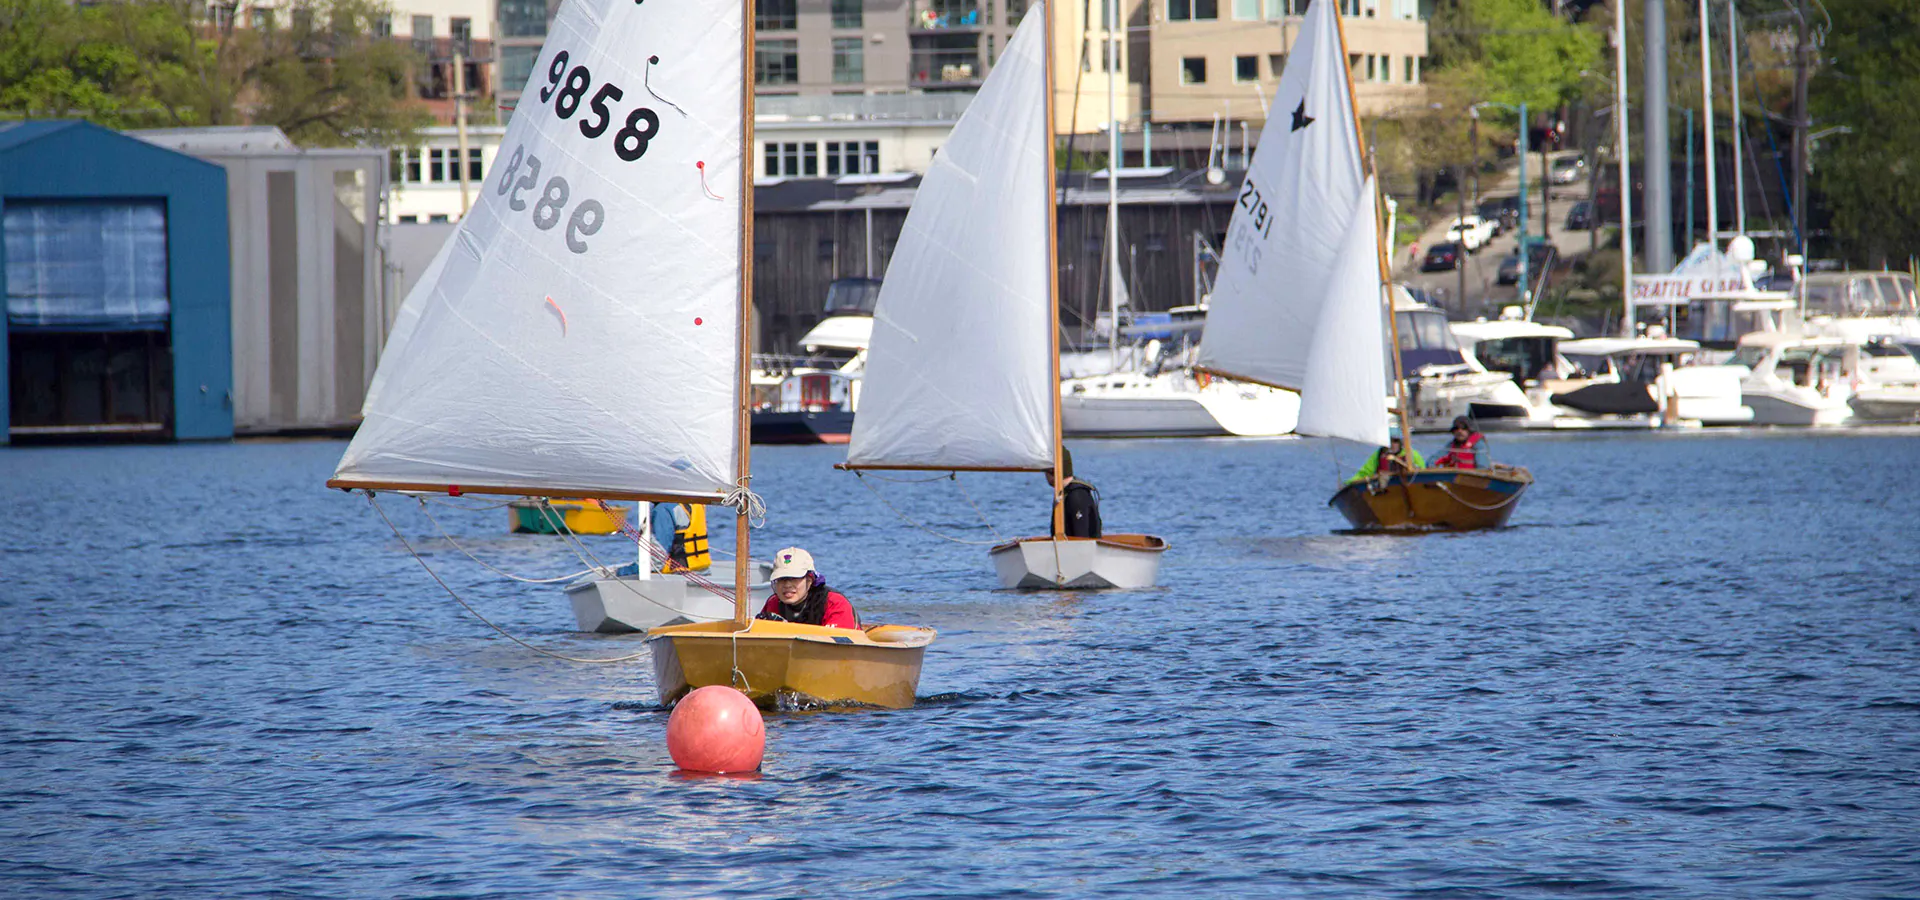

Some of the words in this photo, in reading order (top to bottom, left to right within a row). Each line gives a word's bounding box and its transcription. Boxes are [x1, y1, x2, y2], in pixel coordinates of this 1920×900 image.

[540, 50, 660, 162] 9858
[1240, 179, 1273, 240] 2791
[1633, 279, 1693, 298] SEATTLE
